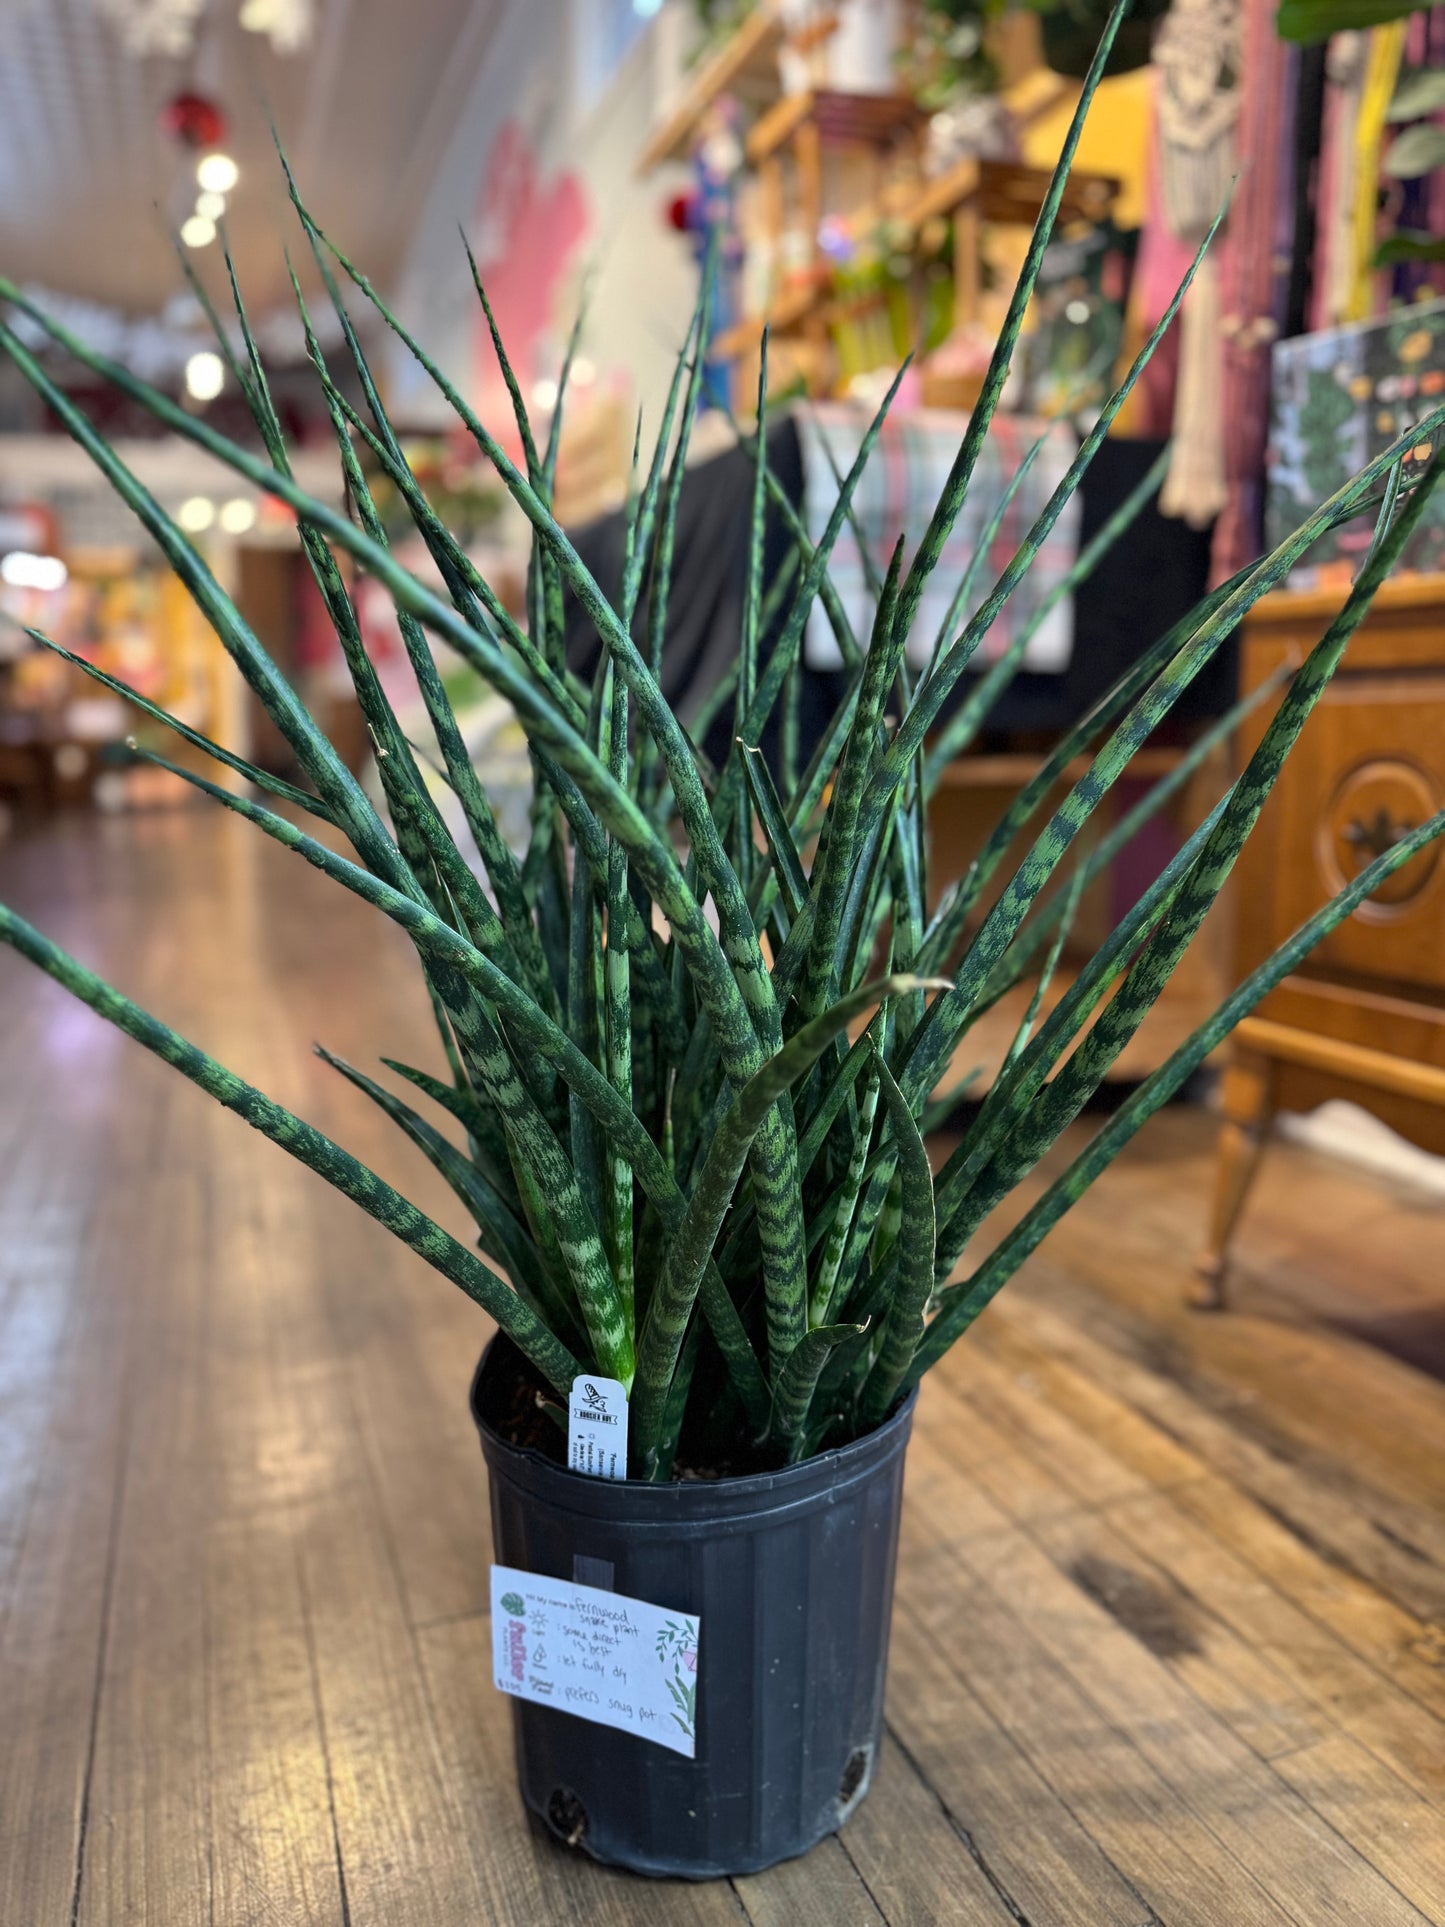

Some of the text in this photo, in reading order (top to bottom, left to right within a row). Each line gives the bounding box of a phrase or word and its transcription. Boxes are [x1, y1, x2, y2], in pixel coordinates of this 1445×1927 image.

[613, 1622, 640, 1637] plant
[592, 1631, 622, 1646] direct
[588, 1642, 612, 1656] best
[582, 1658, 605, 1678] fully
[612, 1665, 627, 1685] dry
[564, 1686, 658, 1722] prefers snug pot
